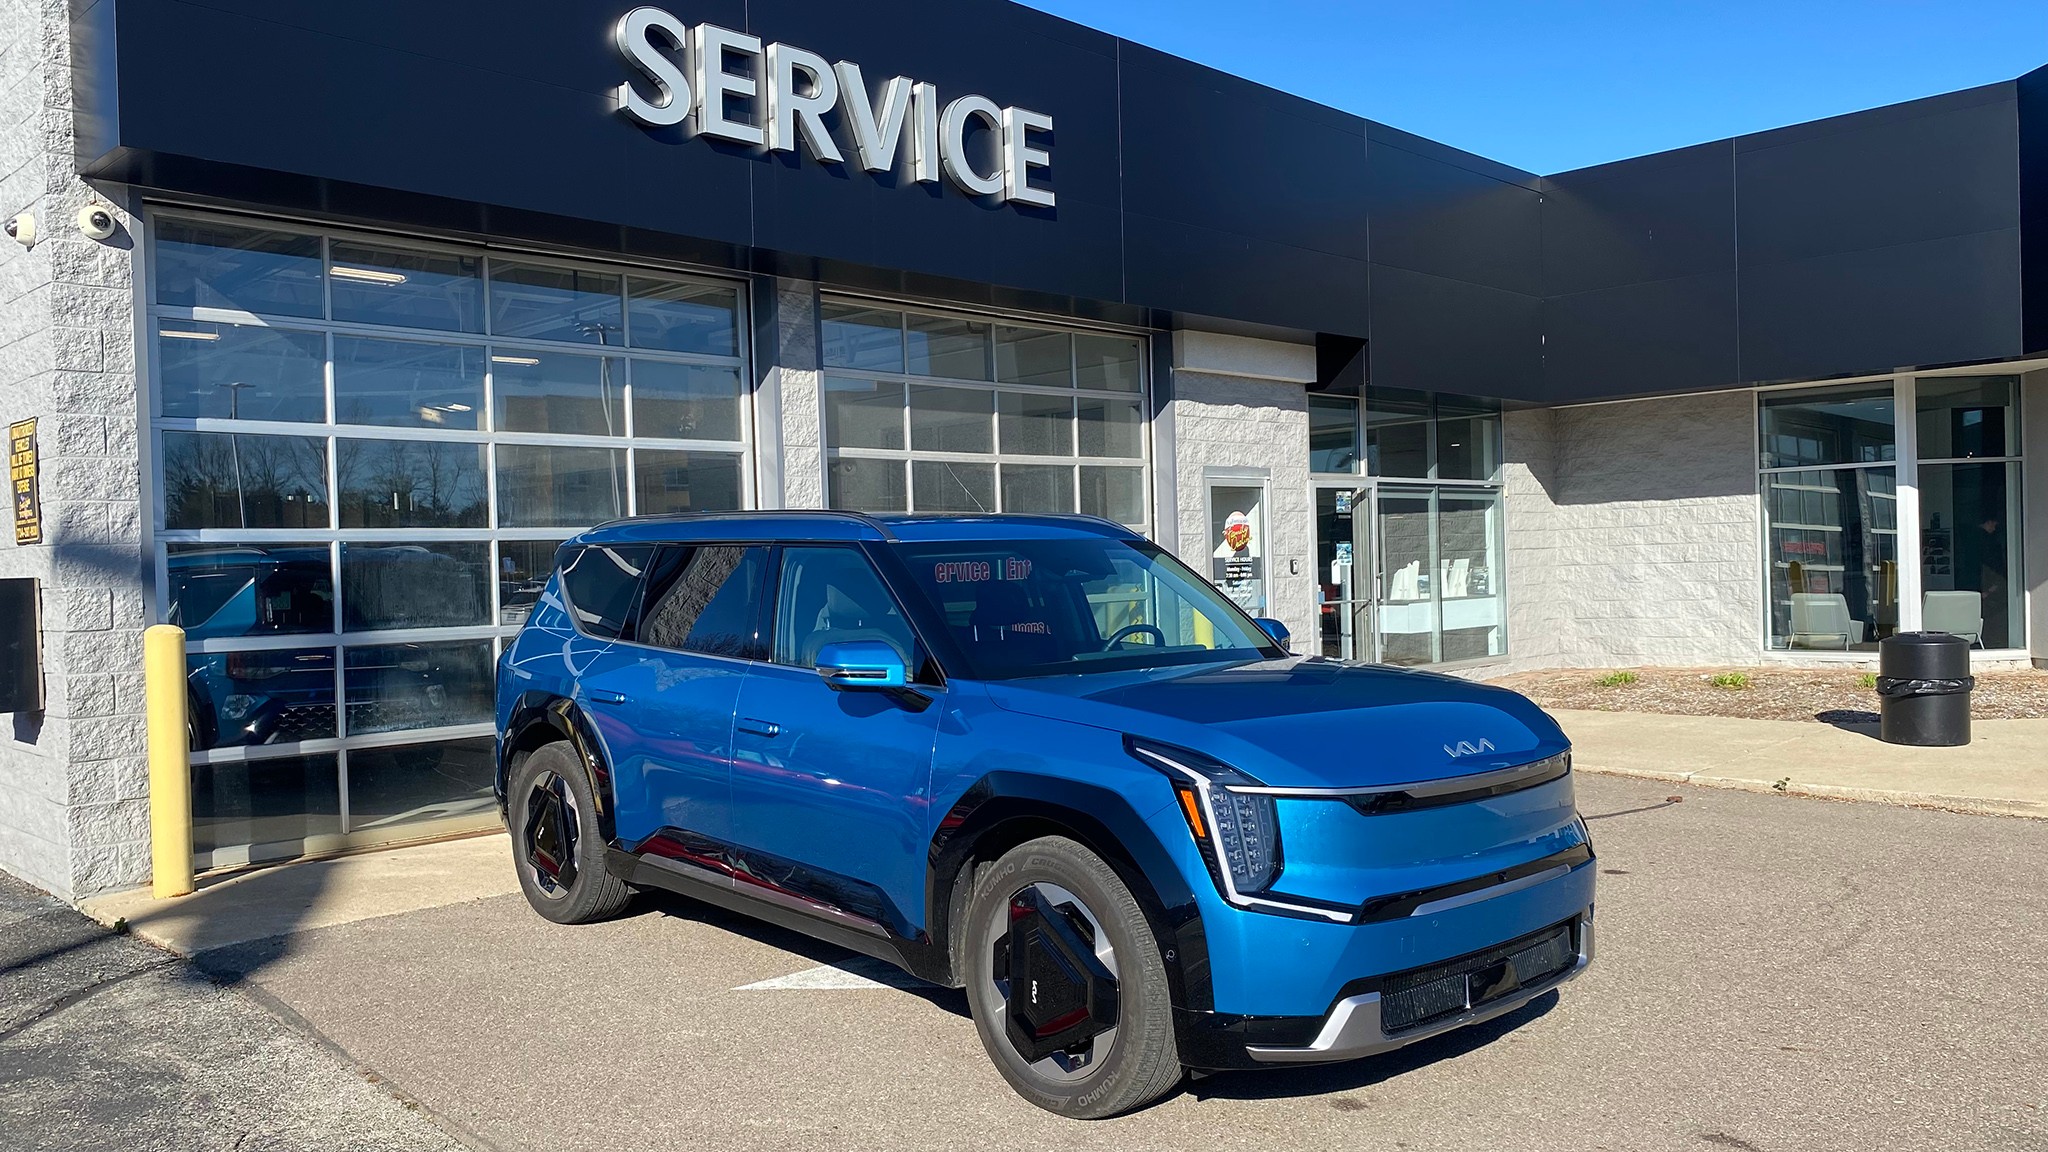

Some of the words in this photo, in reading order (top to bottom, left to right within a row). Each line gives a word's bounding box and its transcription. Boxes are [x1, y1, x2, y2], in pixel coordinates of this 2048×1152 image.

[615, 5, 1056, 207] SERVICE
[1443, 737, 1496, 758] KIA
[981, 862, 1015, 900] KUMHO
[1077, 1070, 1119, 1107] KUMHO
